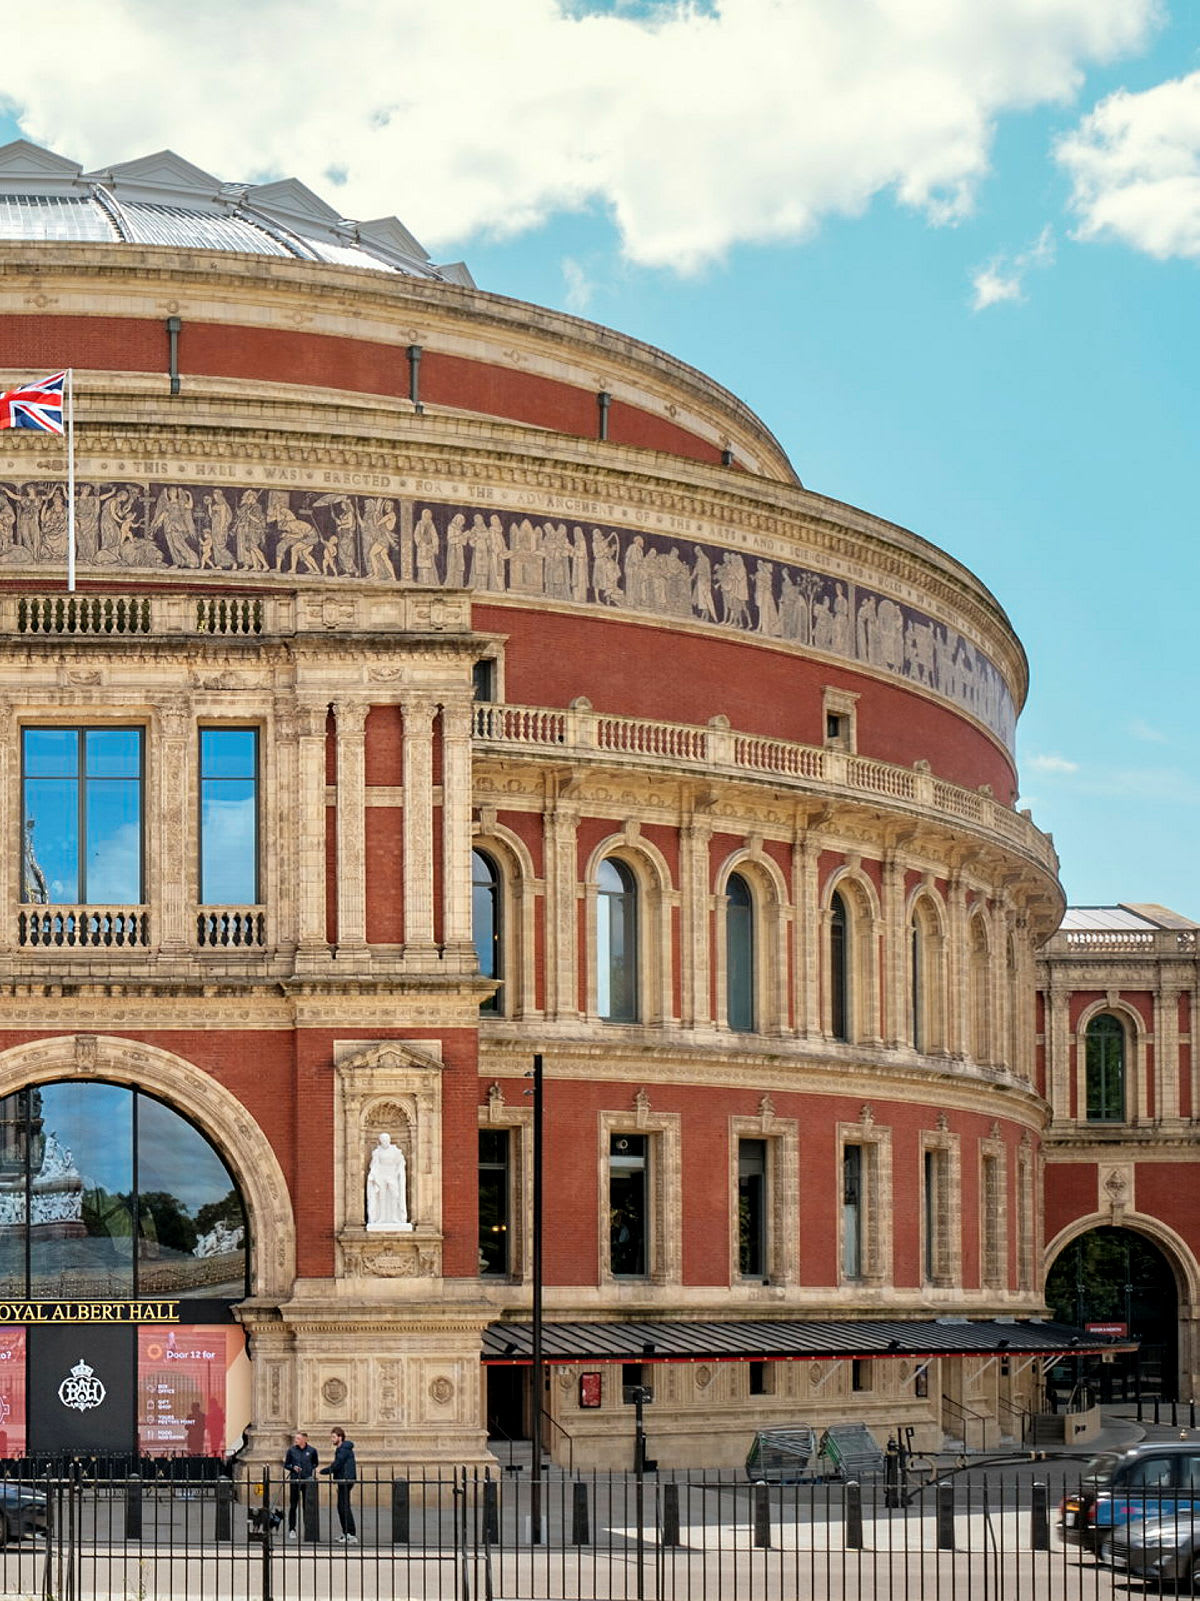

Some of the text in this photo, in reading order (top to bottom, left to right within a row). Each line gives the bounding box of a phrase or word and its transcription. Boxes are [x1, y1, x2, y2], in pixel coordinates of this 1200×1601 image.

[133, 461, 169, 475] THIS
[194, 463, 237, 478] HALL
[262, 466, 298, 481] WAS
[322, 471, 392, 489] ERECTED
[467, 485, 494, 500] THE
[52, 1303, 123, 1320] ALBERT
[129, 1301, 180, 1320] HALL
[166, 1350, 216, 1360] Door 12 for
